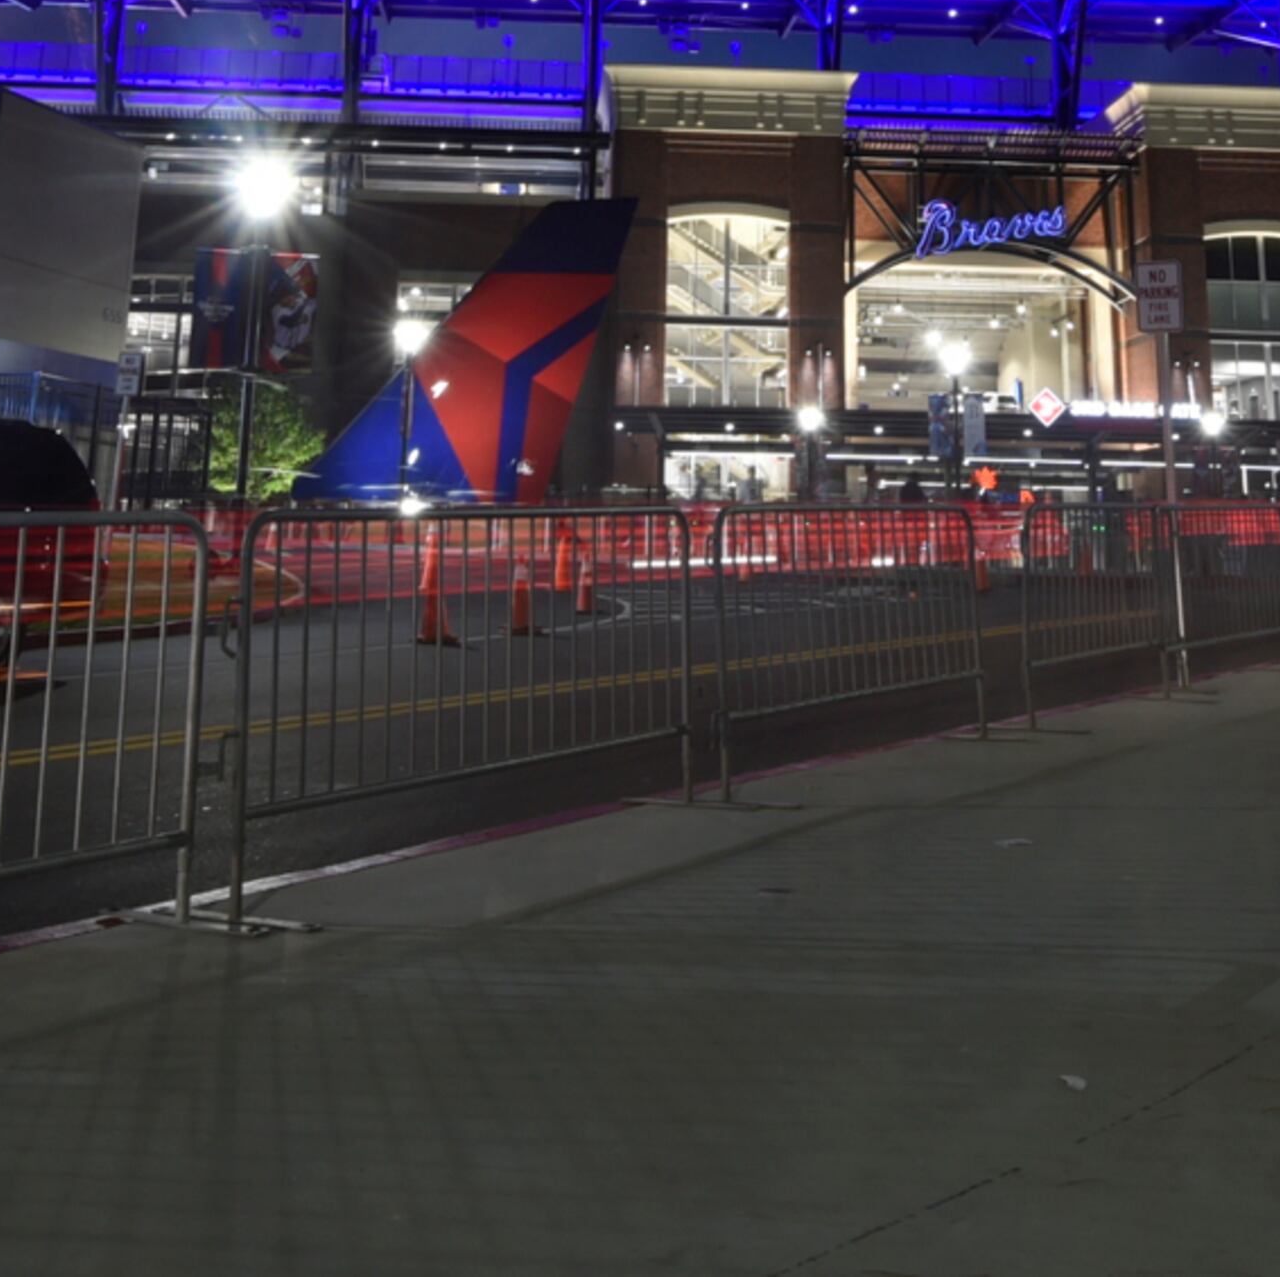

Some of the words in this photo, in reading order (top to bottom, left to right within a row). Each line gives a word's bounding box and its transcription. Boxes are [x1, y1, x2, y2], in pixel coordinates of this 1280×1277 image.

[916, 198, 1066, 258] Braves
[1149, 269, 1166, 283] NO
[1137, 285, 1180, 299] PARKING
